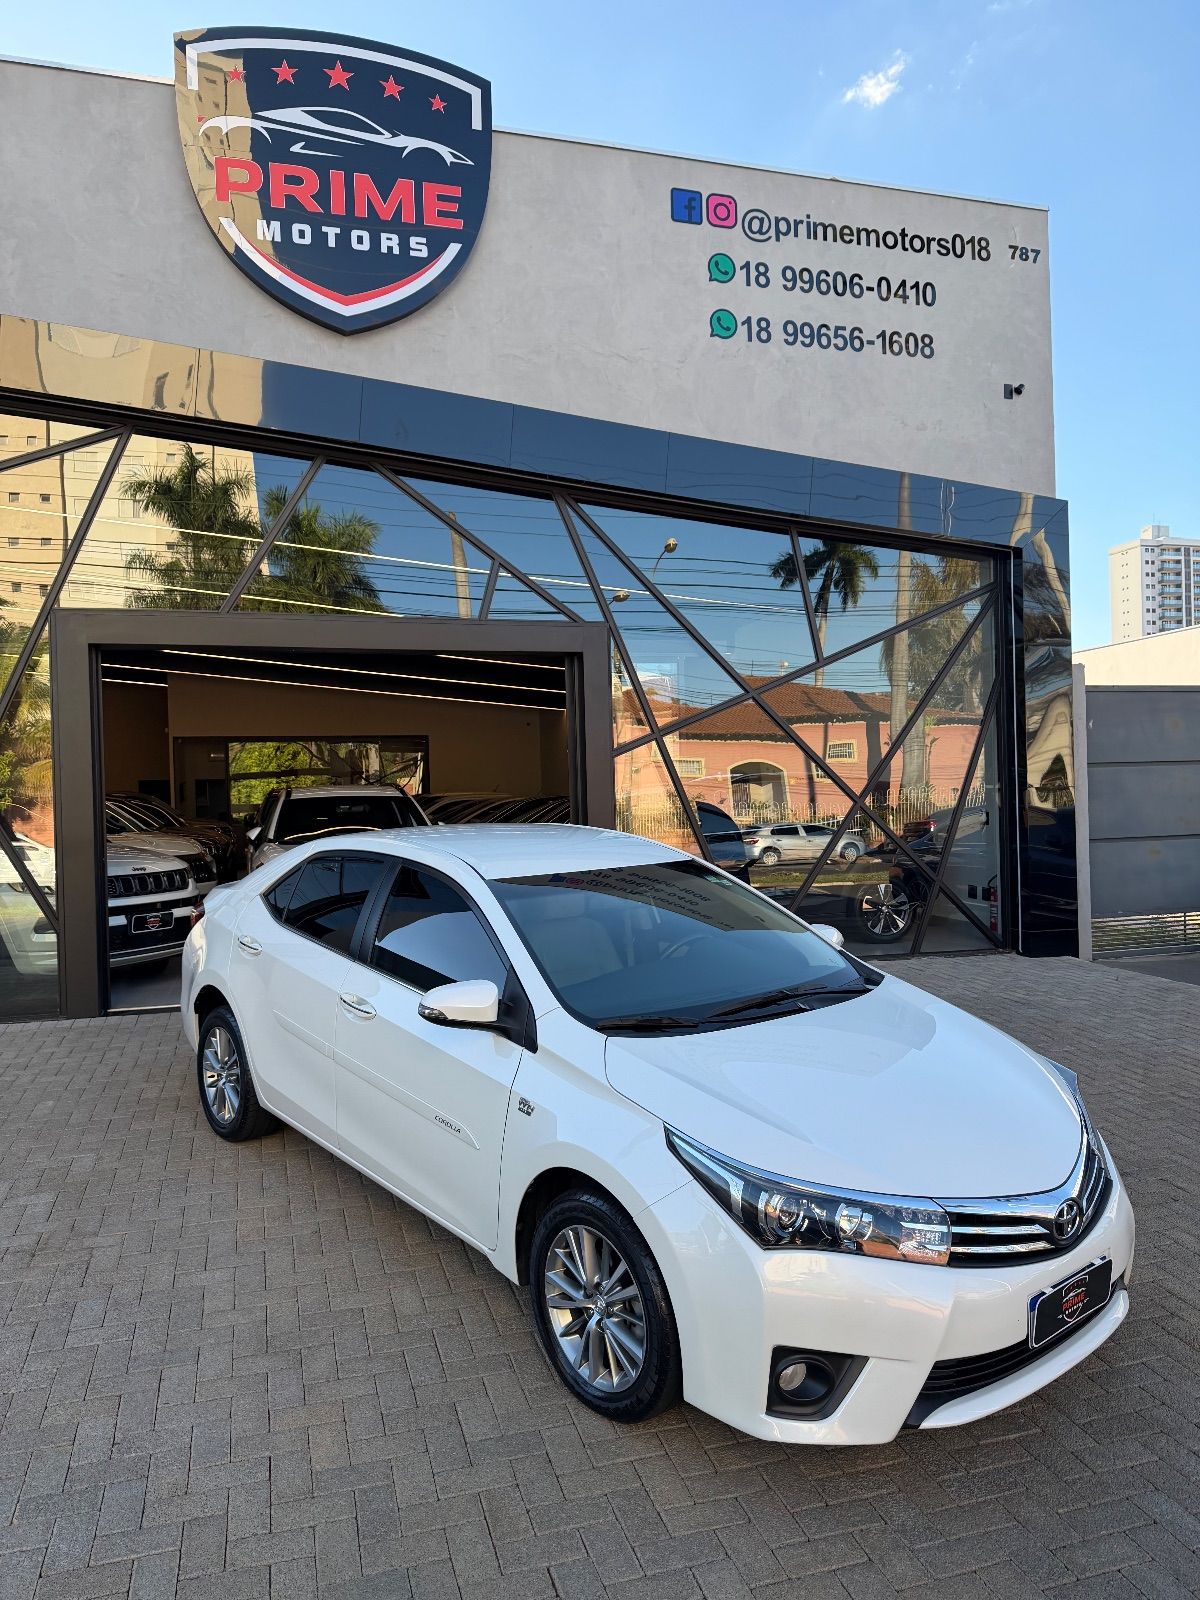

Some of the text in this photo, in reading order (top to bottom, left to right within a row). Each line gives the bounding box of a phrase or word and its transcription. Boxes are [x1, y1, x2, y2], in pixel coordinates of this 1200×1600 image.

[214, 156, 464, 230] PRIME
[256, 218, 428, 258] MOTORS
[741, 208, 991, 262] @primemotors018
[1008, 244, 1041, 264] 787
[739, 260, 936, 307] 18 99606-0410
[740, 316, 935, 359] 18 99656-1608
[434, 1115, 461, 1133] COROLLA
[1062, 1291, 1085, 1311] PRIME
